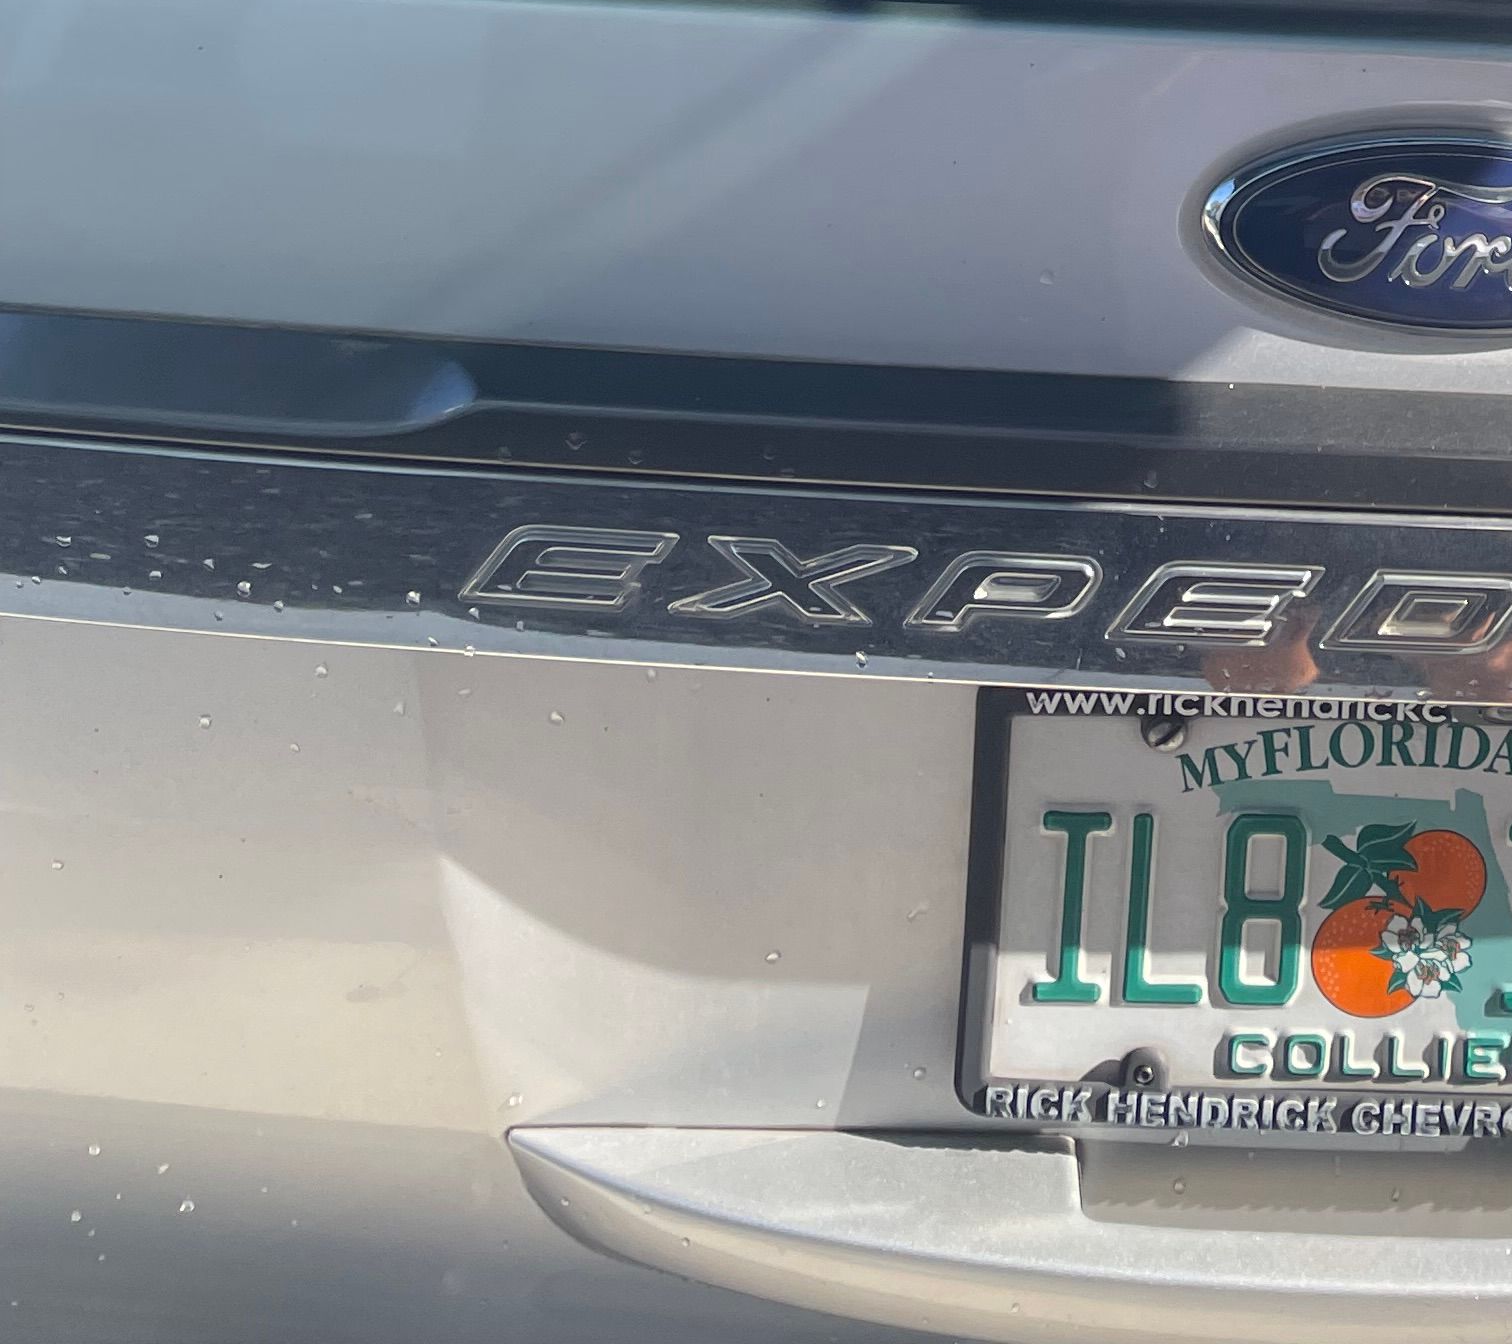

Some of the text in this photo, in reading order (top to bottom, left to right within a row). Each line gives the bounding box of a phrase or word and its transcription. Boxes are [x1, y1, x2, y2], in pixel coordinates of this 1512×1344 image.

[1031, 809, 1308, 1006] IL8
[985, 1085, 1094, 1124] RICK
[1107, 1090, 1338, 1134] HENDRICK
